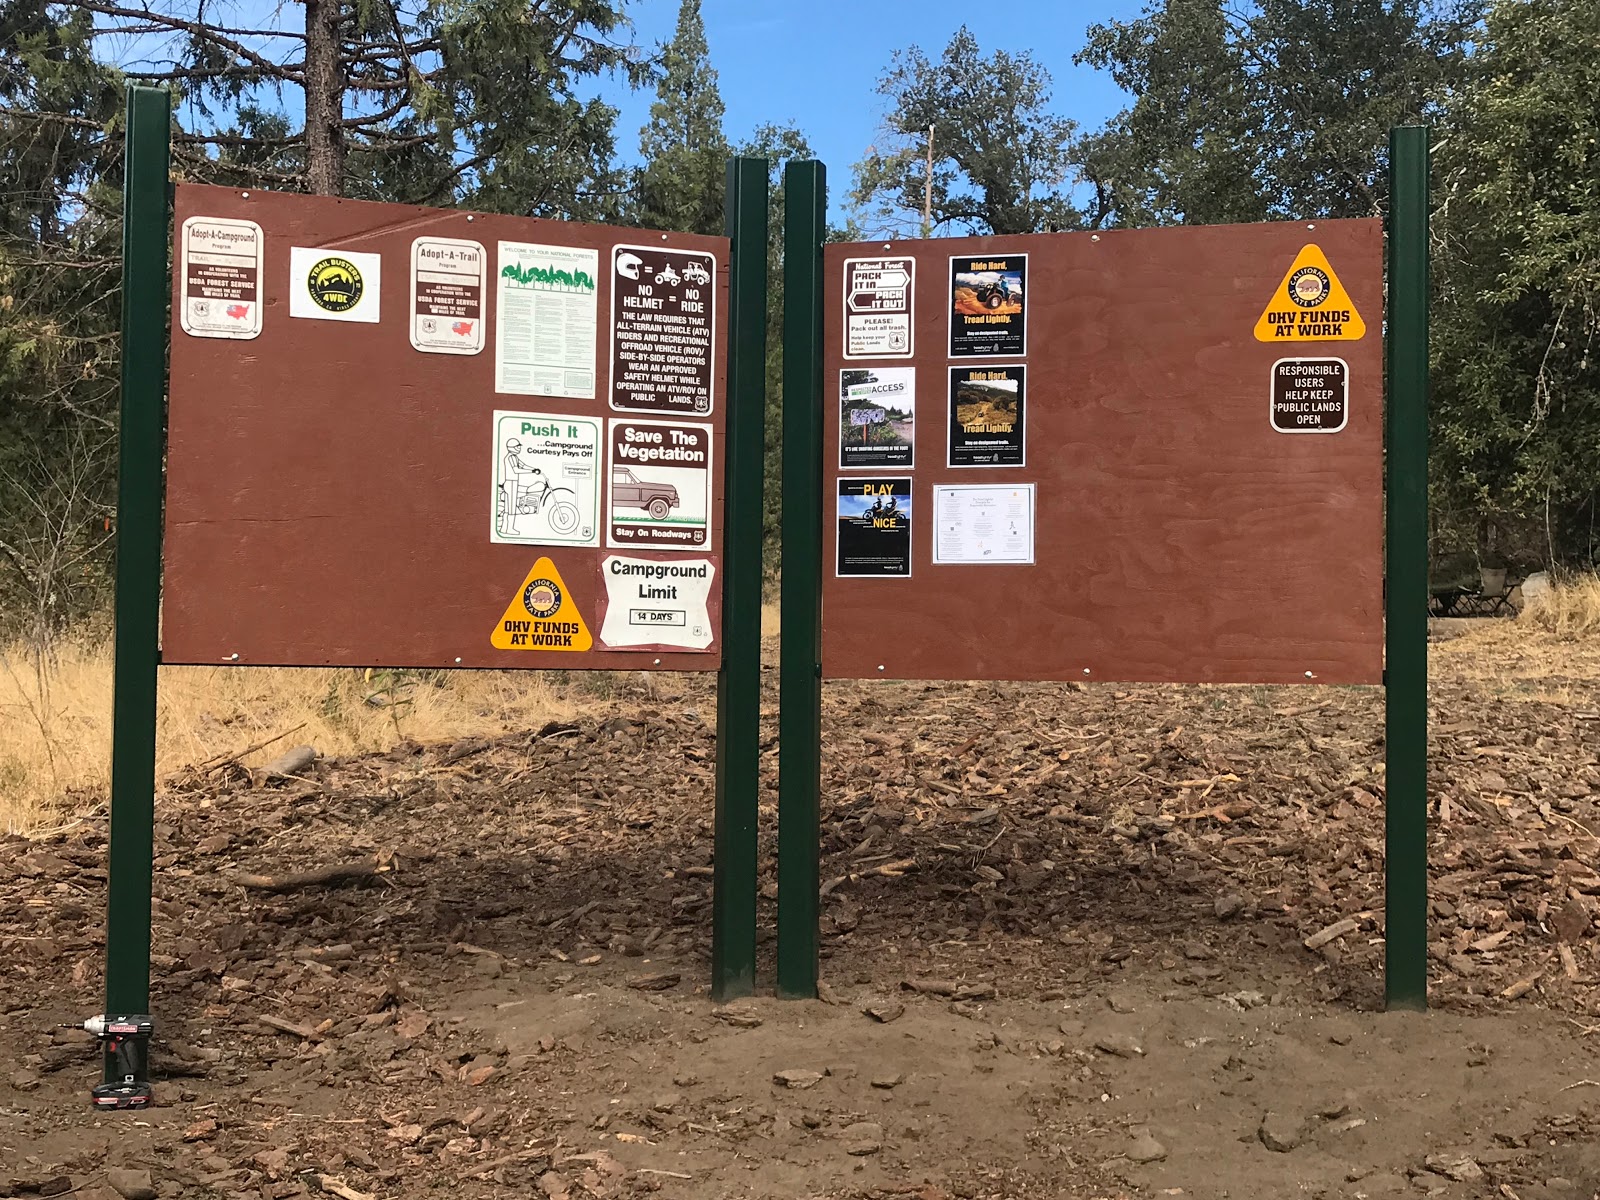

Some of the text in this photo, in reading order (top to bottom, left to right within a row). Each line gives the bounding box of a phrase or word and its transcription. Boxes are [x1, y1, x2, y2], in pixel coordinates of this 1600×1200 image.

[191, 228, 255, 242] Adopt-A-Campground
[420, 248, 477, 261] Adopt-A-Trail
[311, 259, 360, 280] TRAIL BUSTERS
[856, 262, 882, 270] National
[971, 262, 987, 270] Ride
[855, 272, 881, 280] PACK
[1290, 268, 1328, 286] CALIFORNIA
[207, 279, 229, 287] FOREST
[866, 281, 876, 289] IN
[638, 285, 653, 296] NO
[685, 289, 699, 300] NO
[875, 291, 902, 299] PACK
[434, 297, 454, 305] FOREST
[623, 296, 664, 309] HELMET
[1290, 289, 1328, 306] STATE PARKS
[681, 301, 704, 313] RIDE
[871, 300, 903, 308] IT OUT
[622, 312, 705, 326] THE LAW REQUIRES THAT
[964, 315, 1012, 324] Tread Lightly.
[1268, 310, 1350, 324] OHV FUNDS
[617, 322, 710, 337] ALL-TERRAIN VEHICLE (ATV)
[1275, 324, 1342, 336] AT WORK
[617, 332, 709, 346] RIDERS AND RECREATIONAL
[621, 342, 705, 356] OFFROAD VEHICLE (ROV)/
[620, 352, 706, 365] SIDE-BY-SIDE OPERATORS
[628, 362, 697, 374] WEAR AN APPROVED
[1279, 366, 1340, 376] RESPONSIBLE
[624, 372, 700, 385] SAFETY HELMET WHILE
[970, 372, 986, 380] Ride
[617, 382, 707, 395] OPERATING AN ATV/ROV ON
[871, 383, 904, 394] ACCESS
[1295, 378, 1324, 388] USERS
[631, 392, 693, 404] PUBLIC LANDS.
[1285, 390, 1334, 400] HELP KEEP
[1277, 402, 1341, 412] PUBLIC LANDS
[1296, 415, 1321, 424] OPEN
[521, 422, 578, 438] Push It
[963, 424, 1013, 433] Tread Lightly.
[624, 427, 698, 446] Save The
[527, 448, 560, 456] Courtesy
[618, 443, 704, 462] Vegetation
[864, 484, 894, 496] PLAY
[873, 518, 896, 528] NICE
[616, 528, 691, 540] Stay On Roadways
[611, 560, 706, 579] Campground
[525, 579, 560, 596] CALIFORNIA
[639, 584, 677, 599] Limit
[524, 600, 560, 616] STATE PARKS
[650, 613, 673, 621] DAYS
[504, 621, 579, 634] OHV FUNDS
[510, 634, 572, 646] AT WORK
